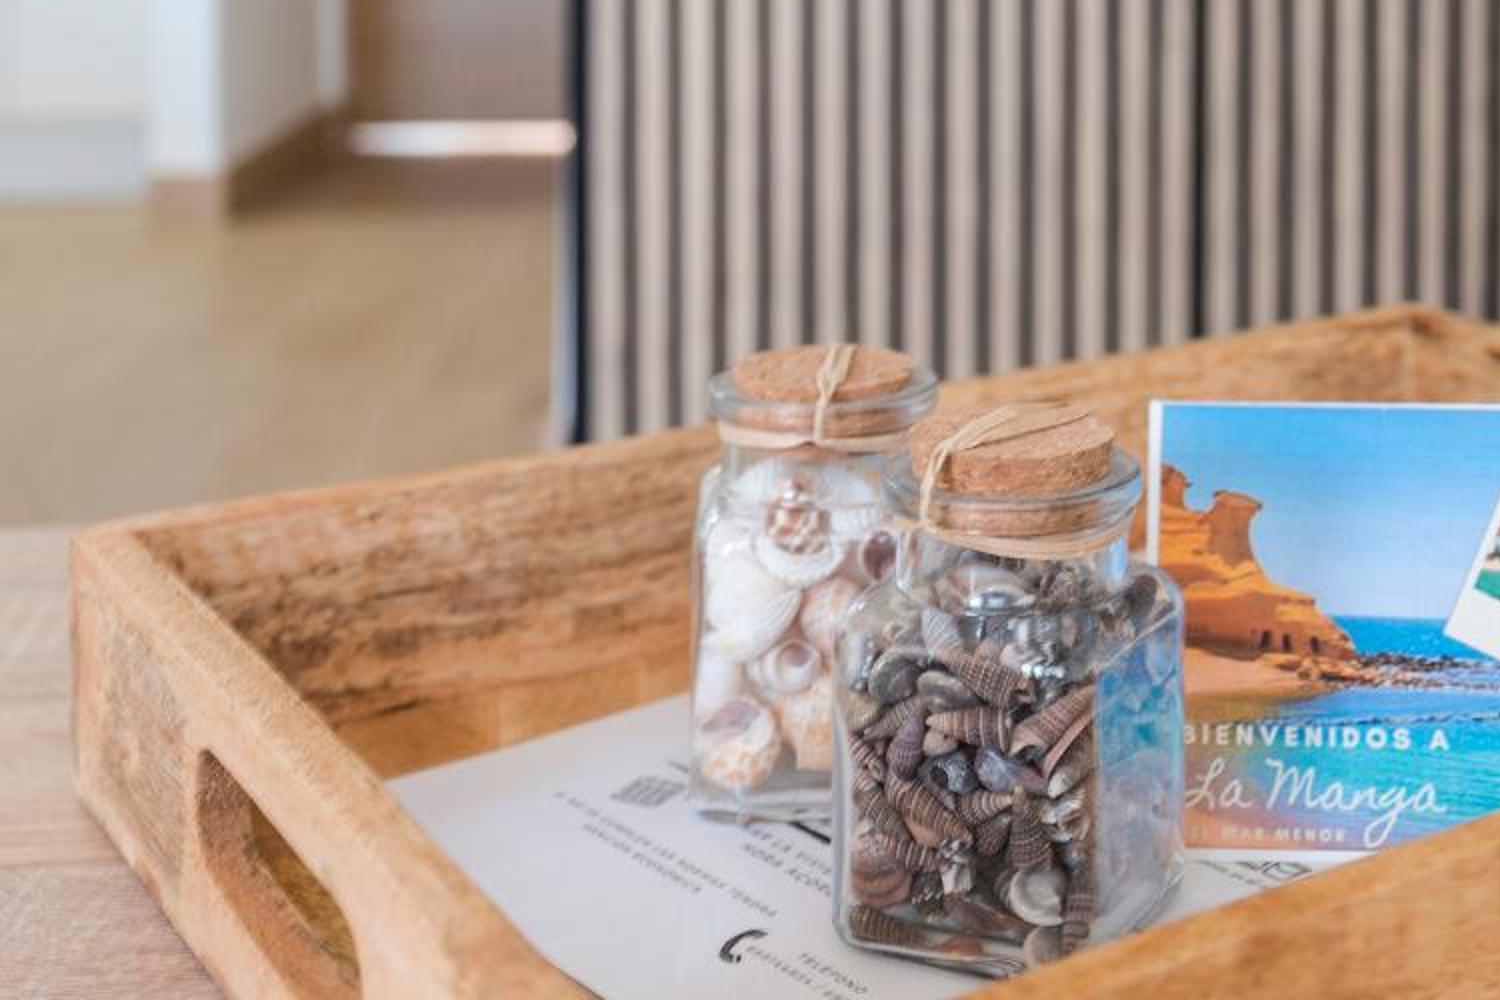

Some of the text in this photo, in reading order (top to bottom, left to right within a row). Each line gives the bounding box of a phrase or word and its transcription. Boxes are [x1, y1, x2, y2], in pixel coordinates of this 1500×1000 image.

[1428, 728, 1449, 751] A
[1184, 757, 1448, 848] La Manga
[1274, 825, 1346, 842] MENOR
